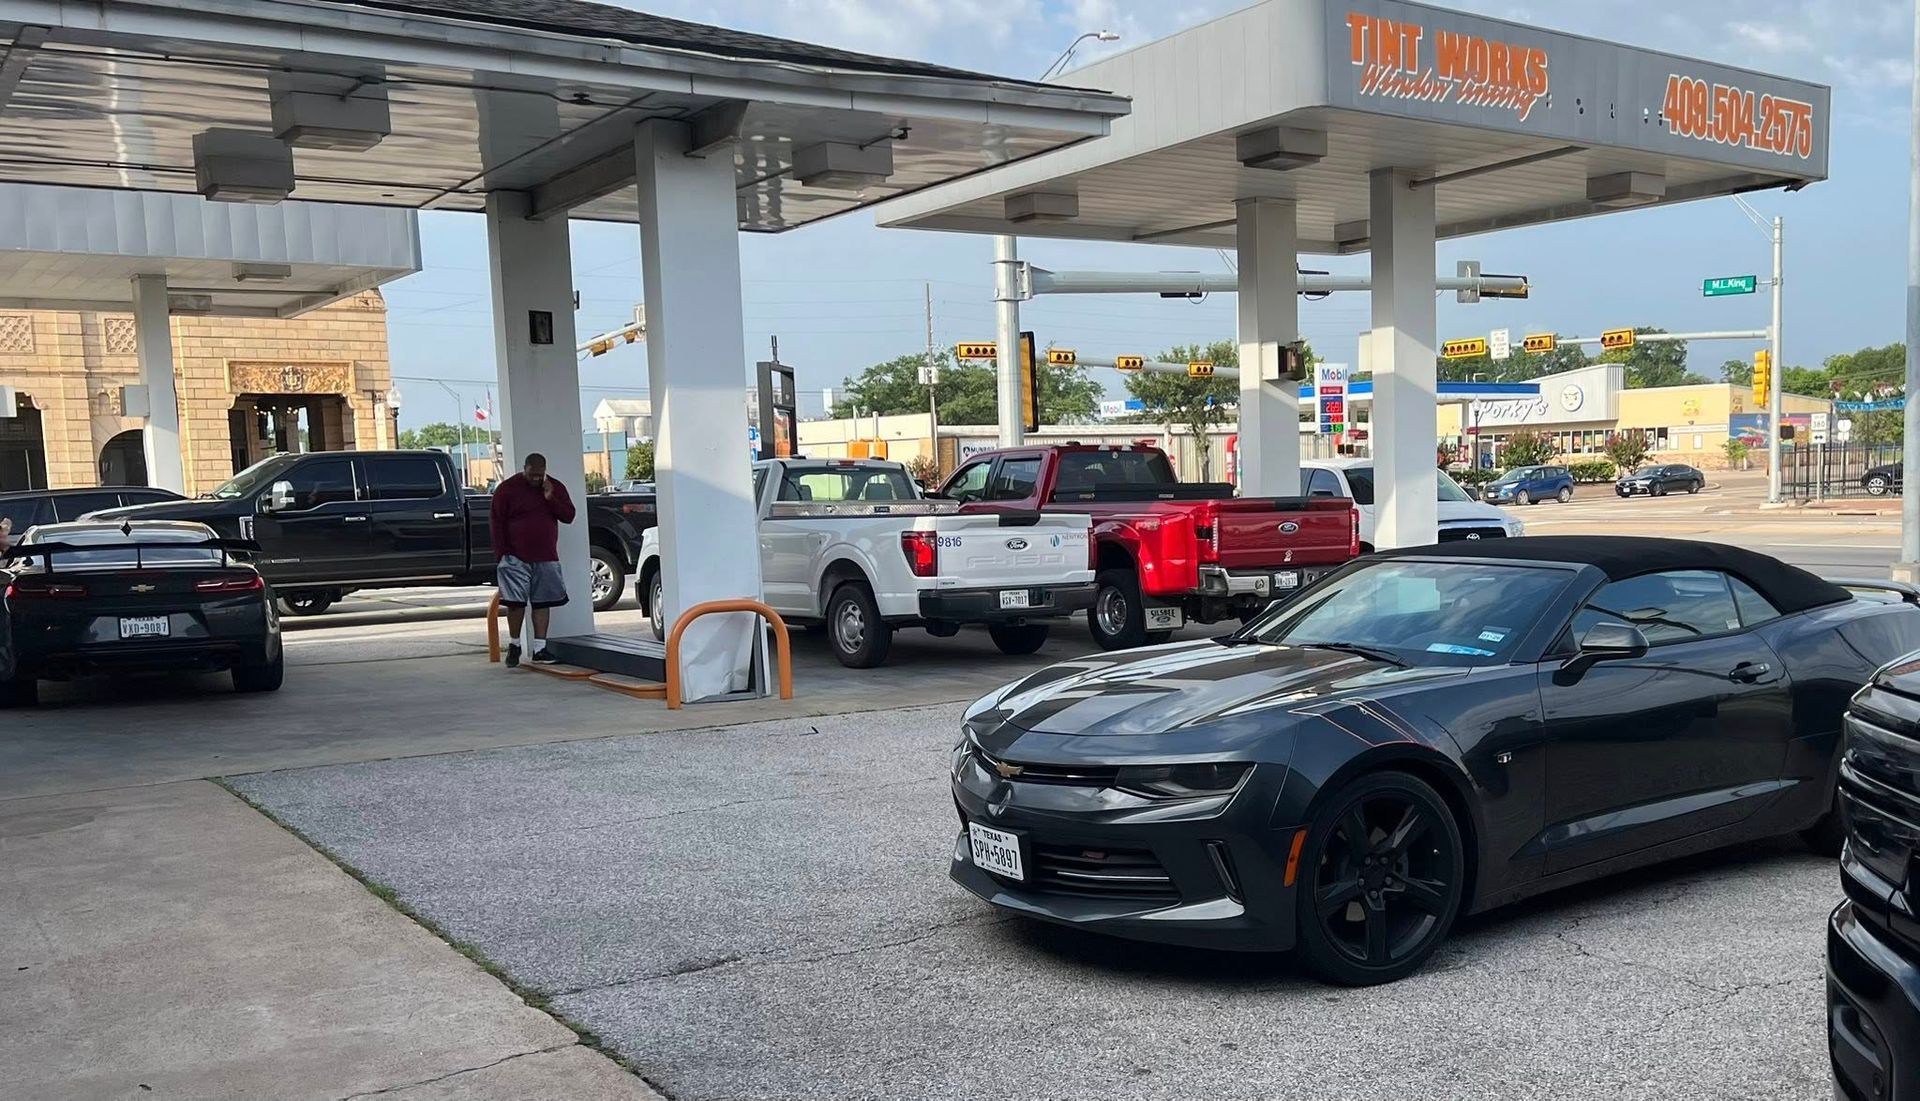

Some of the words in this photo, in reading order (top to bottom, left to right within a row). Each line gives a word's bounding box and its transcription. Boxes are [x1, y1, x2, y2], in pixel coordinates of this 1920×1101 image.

[1346, 12, 1424, 75] TINT
[1436, 28, 1549, 97] WORKS
[1360, 63, 1453, 103] Window
[1663, 74, 1812, 159] 409.504.2575
[1728, 278, 1747, 288] King
[1322, 369, 1347, 380] Mobil
[1478, 395, 1548, 423] Porky's
[937, 537, 962, 548] 9816
[1008, 539, 1028, 550] Ford
[1150, 608, 1176, 619] SILSBEE
[982, 829, 1002, 843] TEXAS
